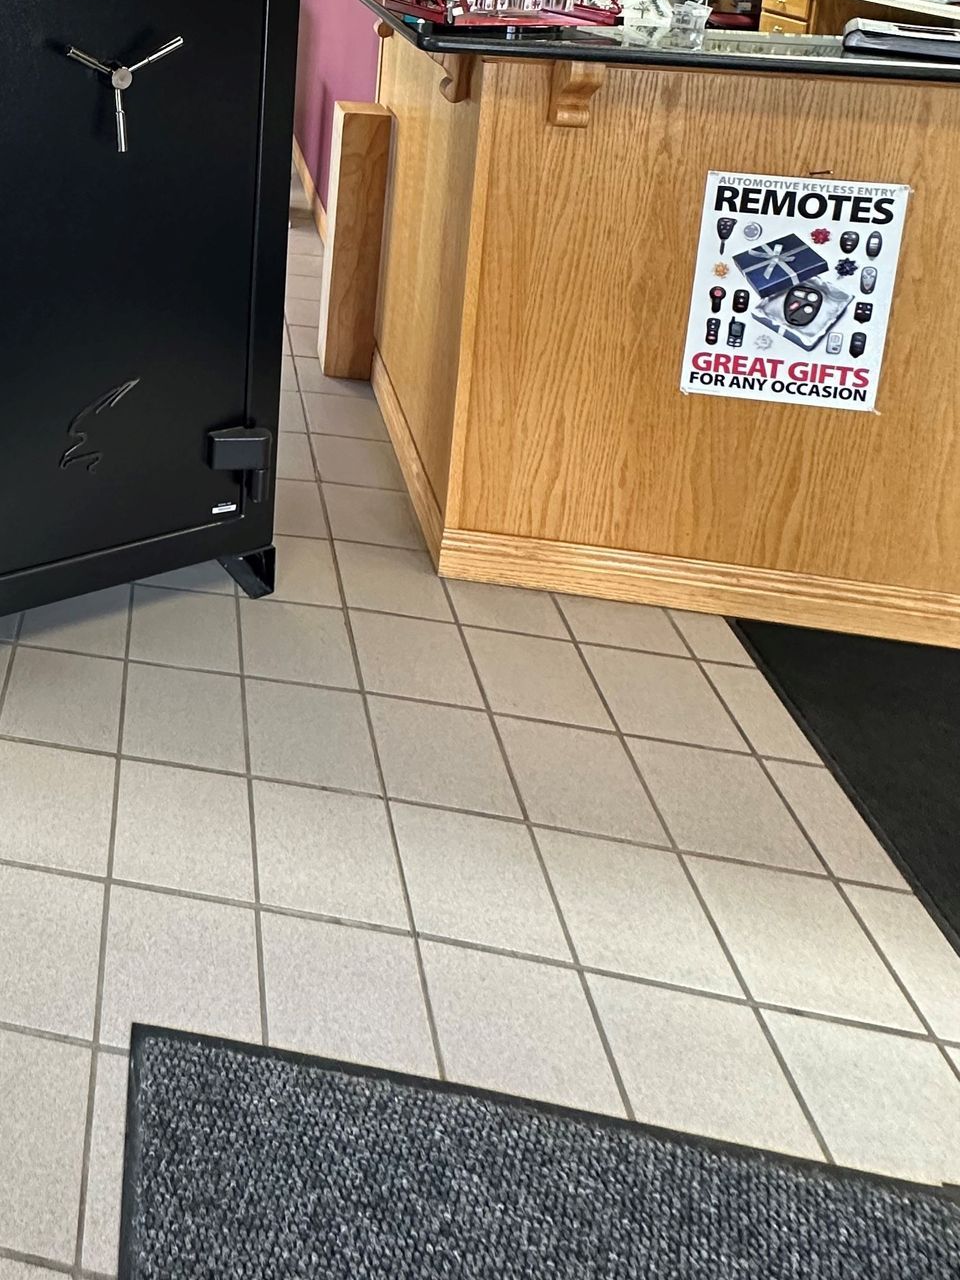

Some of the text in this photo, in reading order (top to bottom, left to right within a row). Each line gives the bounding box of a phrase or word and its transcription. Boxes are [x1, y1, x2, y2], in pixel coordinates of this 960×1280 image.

[718, 176, 897, 198] AUTOMOTIVE KEYLESS ENTRY
[714, 186, 895, 225] REMOTES
[689, 371, 867, 402] FOR ANY OCCASION
[691, 352, 870, 388] GREAT GIFTS
